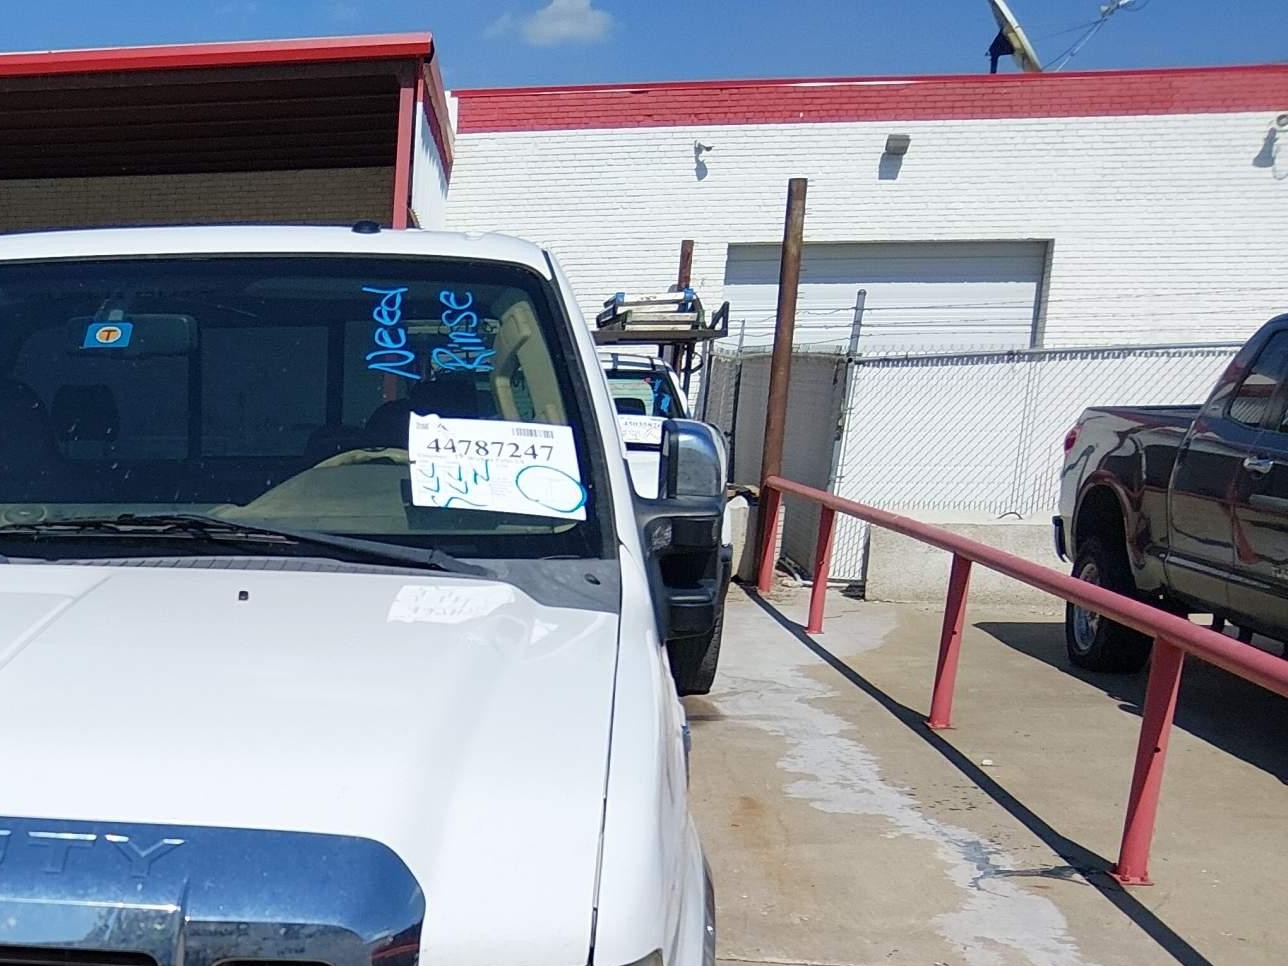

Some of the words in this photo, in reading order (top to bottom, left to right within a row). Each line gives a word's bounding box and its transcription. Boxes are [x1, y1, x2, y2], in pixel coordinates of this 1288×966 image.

[362, 286, 422, 380] Need
[431, 290, 496, 372] Rinse
[426, 437, 554, 461] 44787247
